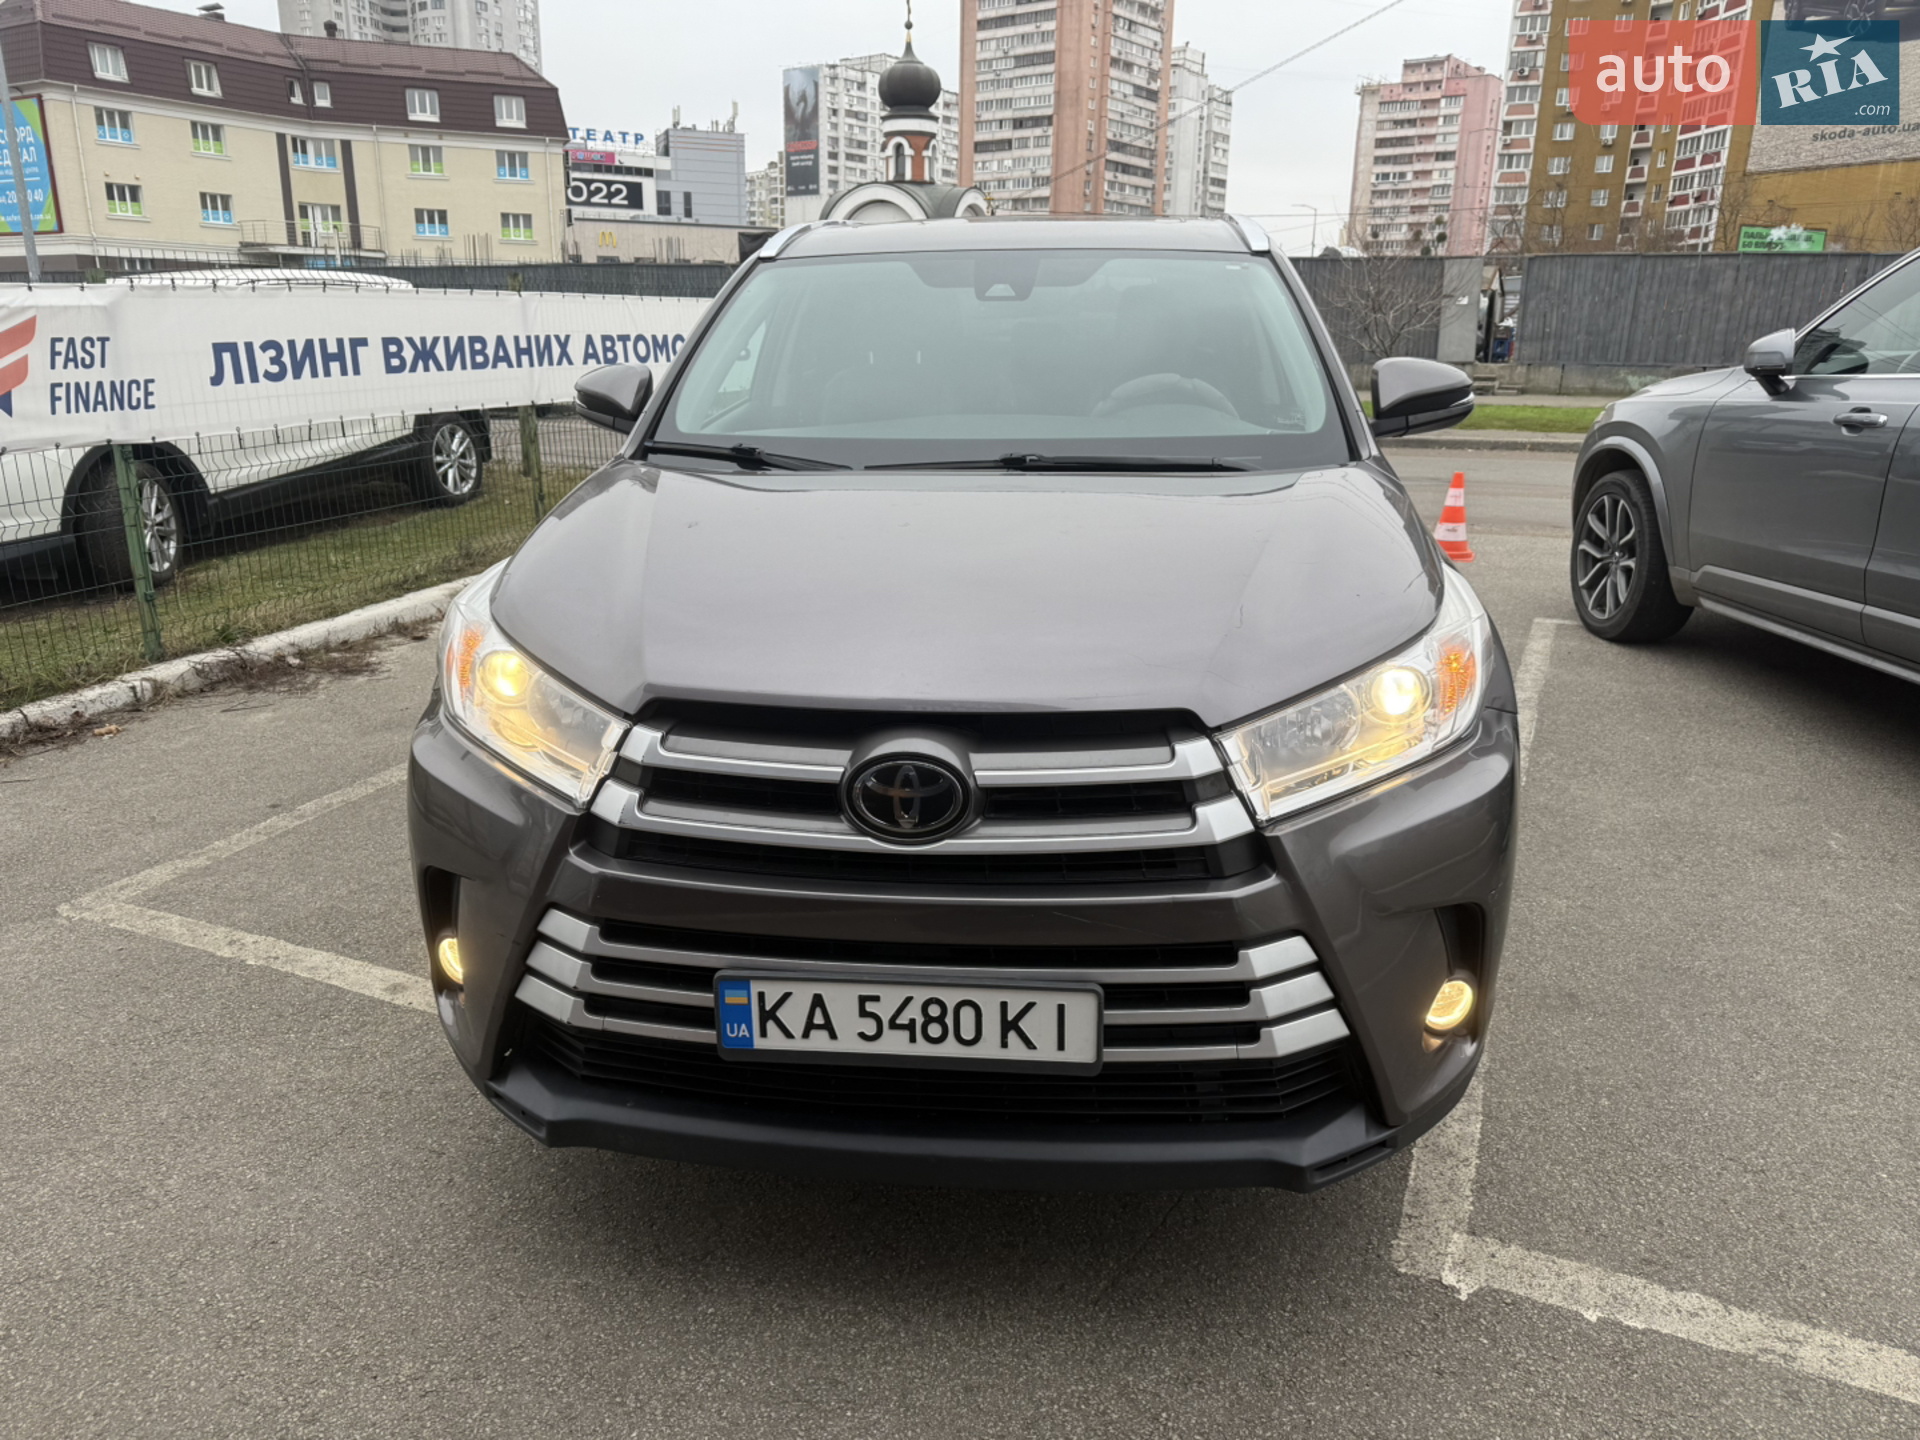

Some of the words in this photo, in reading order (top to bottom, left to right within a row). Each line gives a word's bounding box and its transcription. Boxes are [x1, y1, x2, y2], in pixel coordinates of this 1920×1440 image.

[568, 127, 645, 145] ТЕАТР
[1812, 122, 1920, 142] skoda-auto.ua
[50, 336, 110, 370] FAST
[209, 337, 369, 387] ЛІЗИНГ
[381, 334, 575, 375] ВЖИВАНИХ
[50, 378, 156, 416] FINANCE
[726, 1023, 750, 1038] UA
[757, 991, 838, 1041] KA
[857, 994, 983, 1046] 5480
[1000, 1000, 1066, 1052] KI
